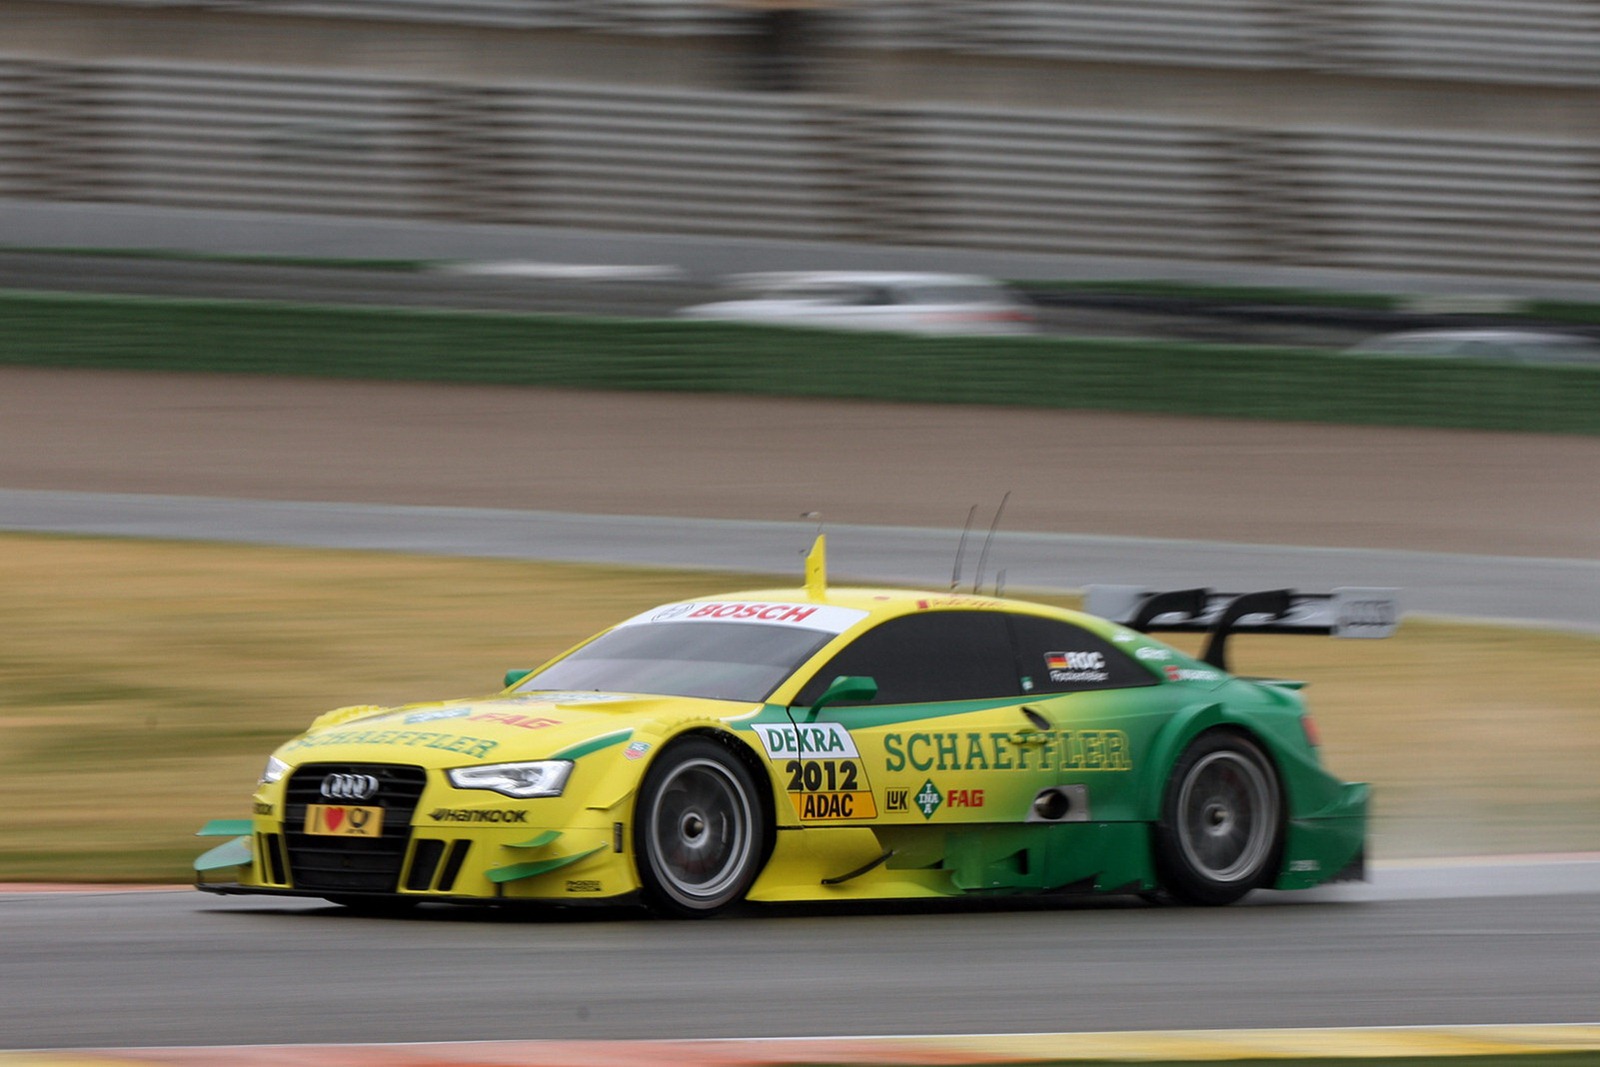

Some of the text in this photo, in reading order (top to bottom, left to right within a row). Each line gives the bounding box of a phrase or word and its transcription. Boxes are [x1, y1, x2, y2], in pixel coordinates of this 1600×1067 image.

[687, 604, 817, 622] BOSCH
[469, 712, 562, 730] FAG
[288, 729, 499, 760] SCHAEFFLER
[767, 728, 845, 752] DEKRA
[884, 730, 1132, 772] SCHAEFFLER
[786, 760, 858, 791] 2012
[803, 794, 853, 818] ADAC
[947, 789, 984, 807] FAG
